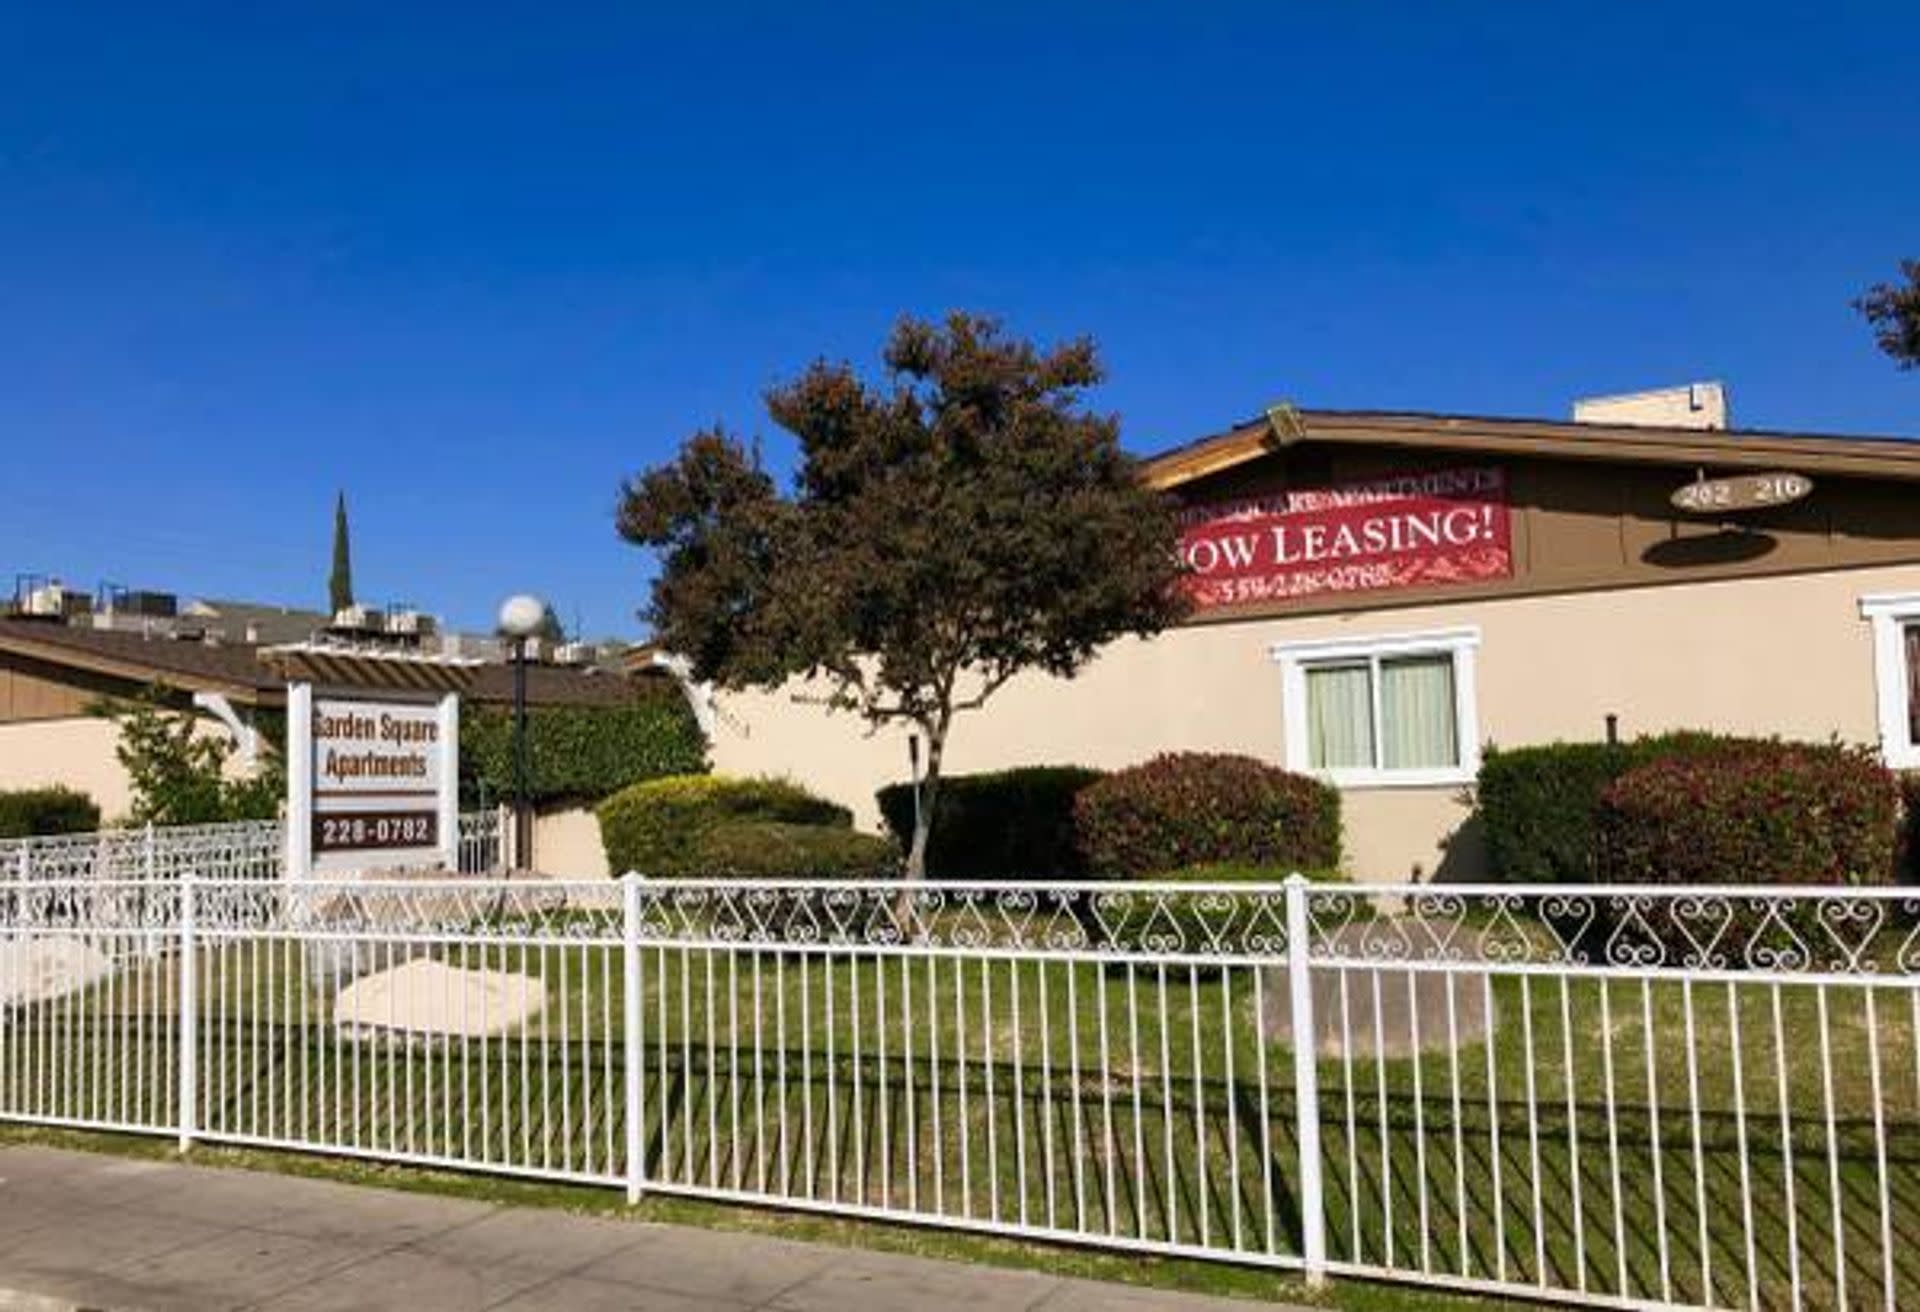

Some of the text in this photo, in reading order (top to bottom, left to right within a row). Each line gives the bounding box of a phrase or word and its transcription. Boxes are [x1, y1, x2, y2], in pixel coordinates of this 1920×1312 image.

[1754, 478, 1801, 501] 216
[1270, 503, 1496, 565] LEASING!
[380, 712, 439, 747] Square
[325, 748, 428, 784] Apartments
[322, 819, 428, 844] 228-0782
